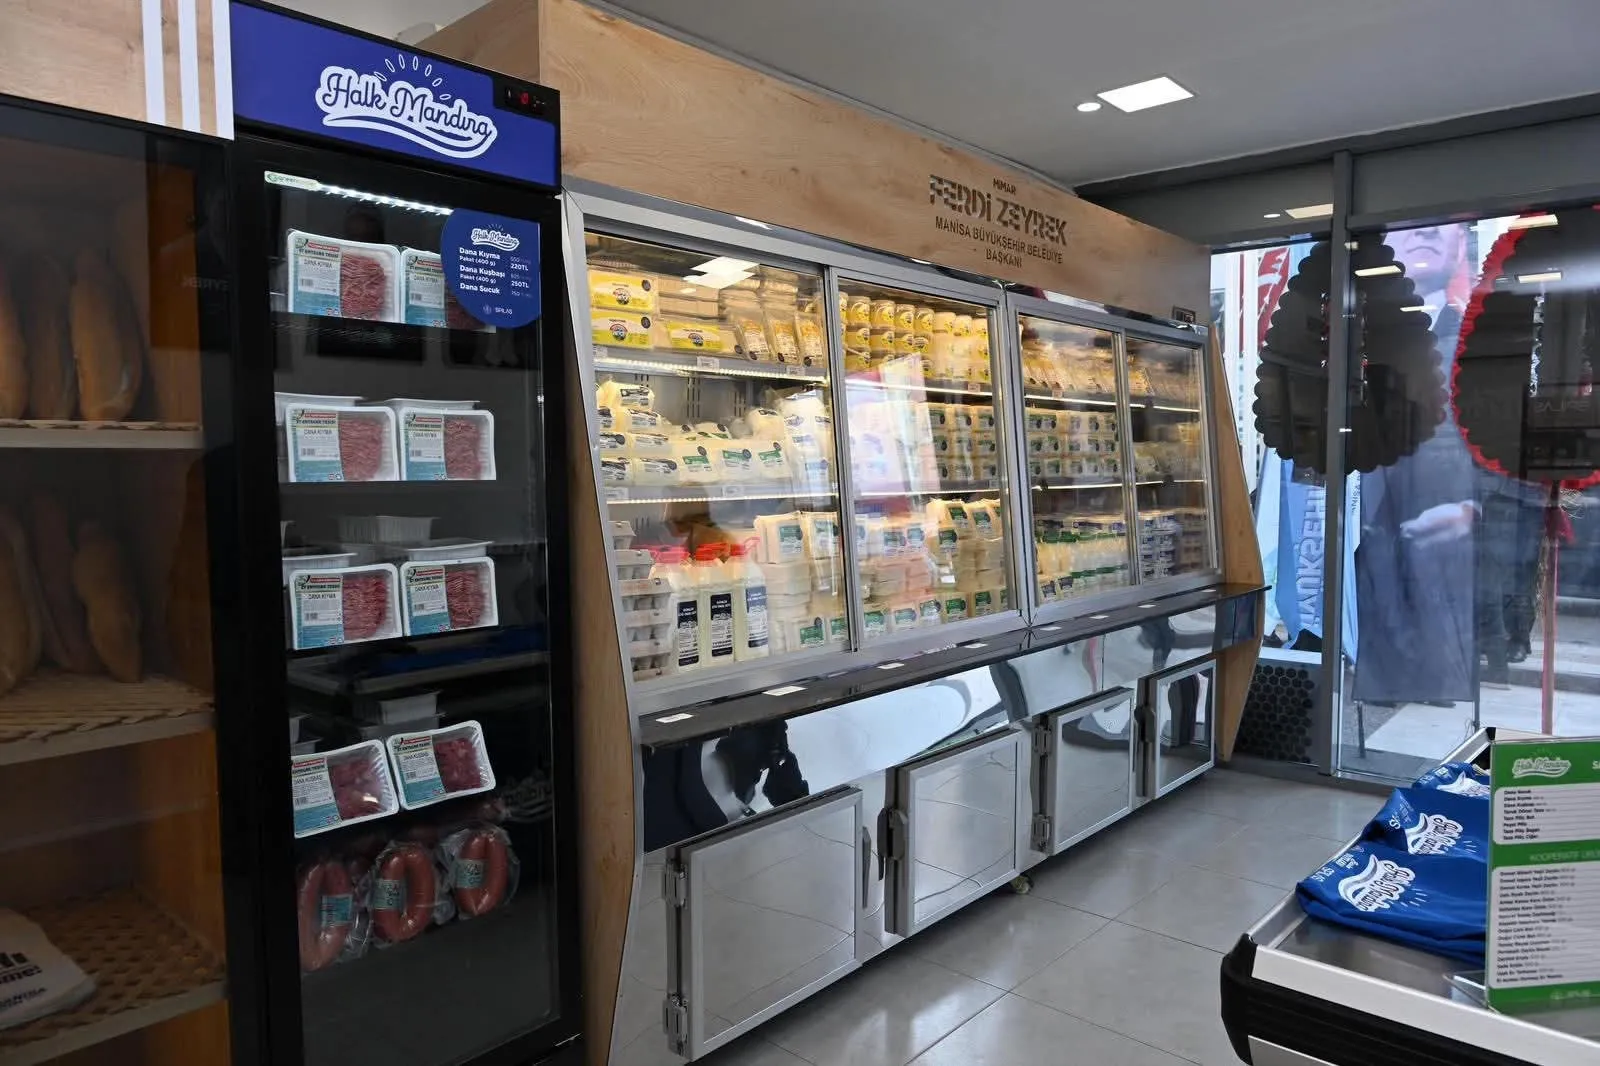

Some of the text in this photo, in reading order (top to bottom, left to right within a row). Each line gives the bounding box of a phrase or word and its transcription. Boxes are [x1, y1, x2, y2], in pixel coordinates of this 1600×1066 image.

[322, 73, 387, 110] Halk
[929, 174, 1068, 247] FERDİ ZEYREK
[935, 215, 971, 239] MANİSA
[459, 247, 501, 260] Dana Kıyma
[459, 264, 478, 274] Dana
[510, 262, 529, 272] 220TL
[459, 282, 501, 295] Dana Sucuk
[511, 280, 530, 289] 250TL
